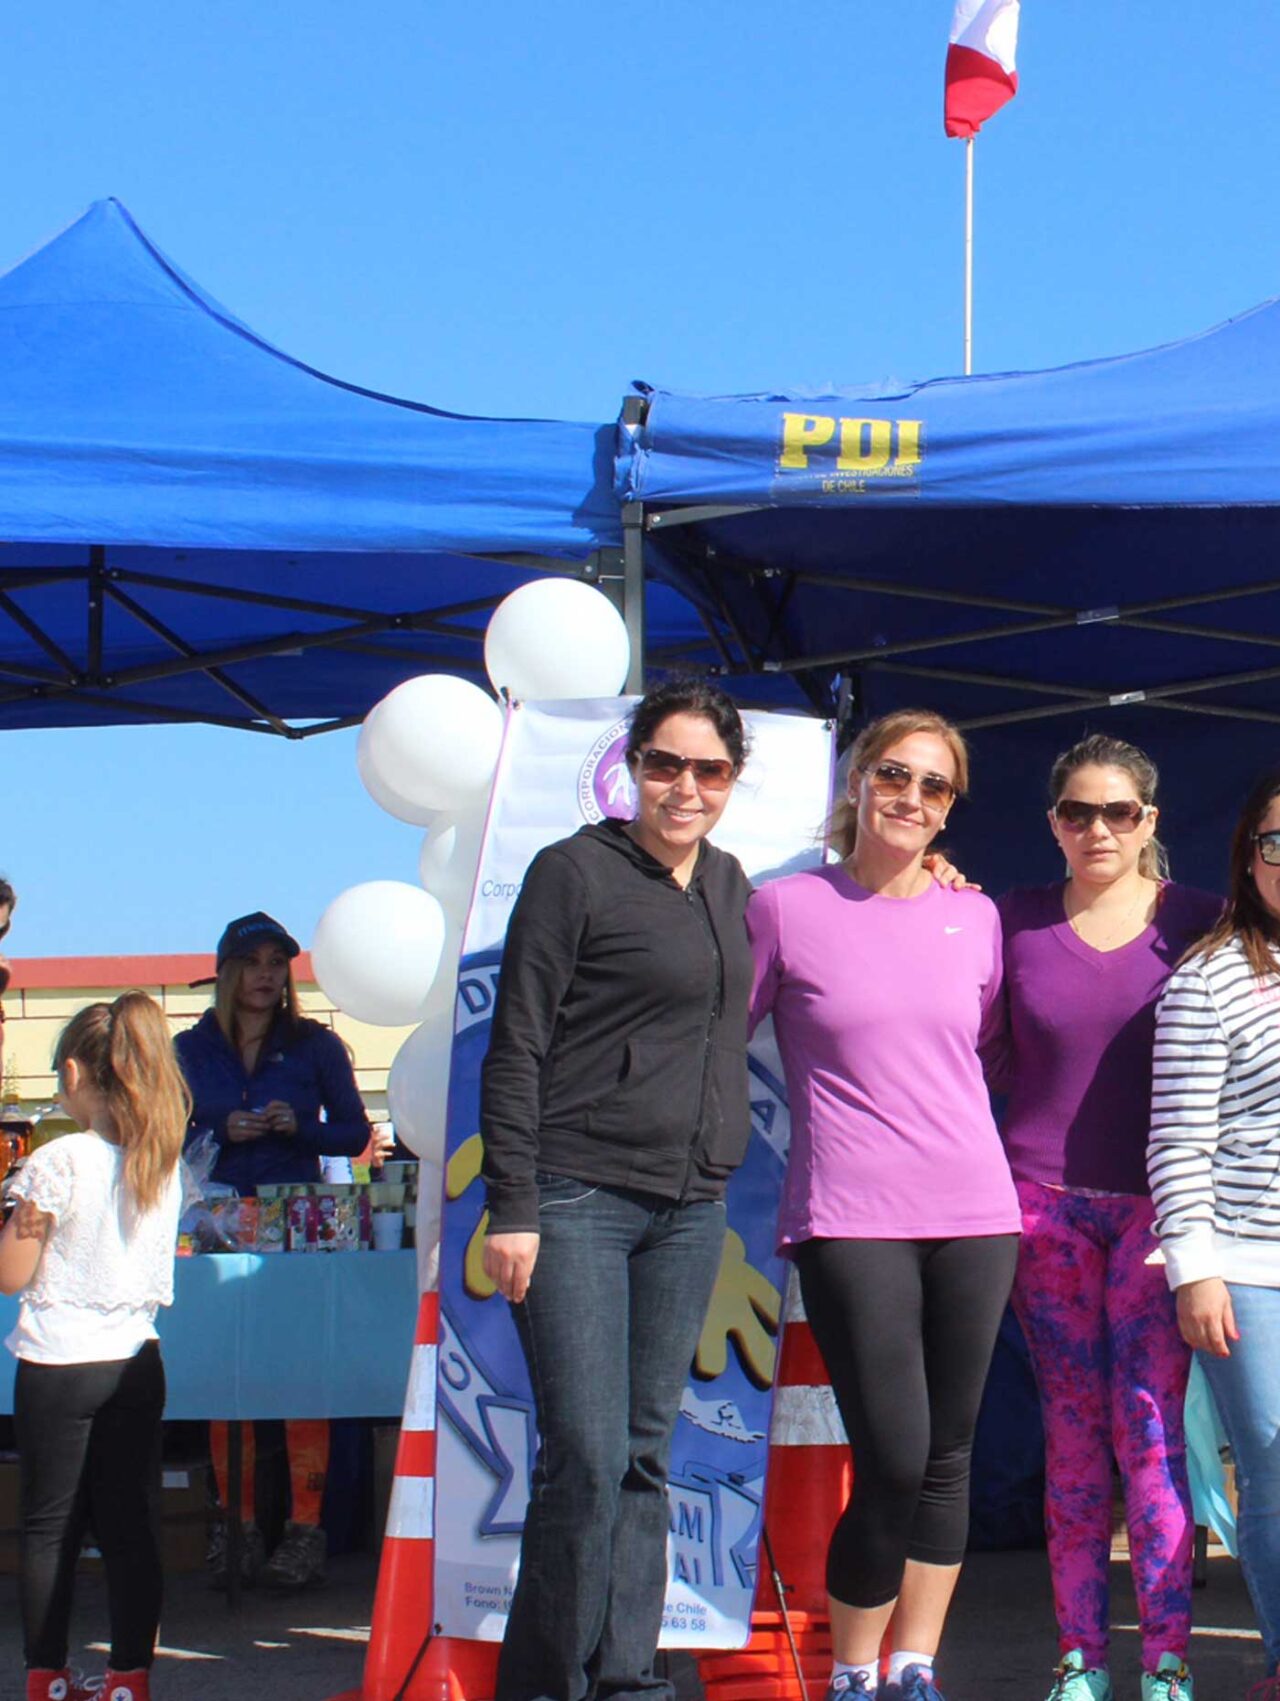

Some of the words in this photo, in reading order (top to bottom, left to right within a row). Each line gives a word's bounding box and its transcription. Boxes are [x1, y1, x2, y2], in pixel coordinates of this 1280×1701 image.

[779, 412, 923, 470] PDI
[821, 479, 836, 493] DE
[838, 479, 867, 494] CHILE
[464, 1582, 501, 1595] Brown
[676, 1602, 707, 1615] Chile
[671, 1617, 687, 1629] 63
[691, 1618, 706, 1631] 58
